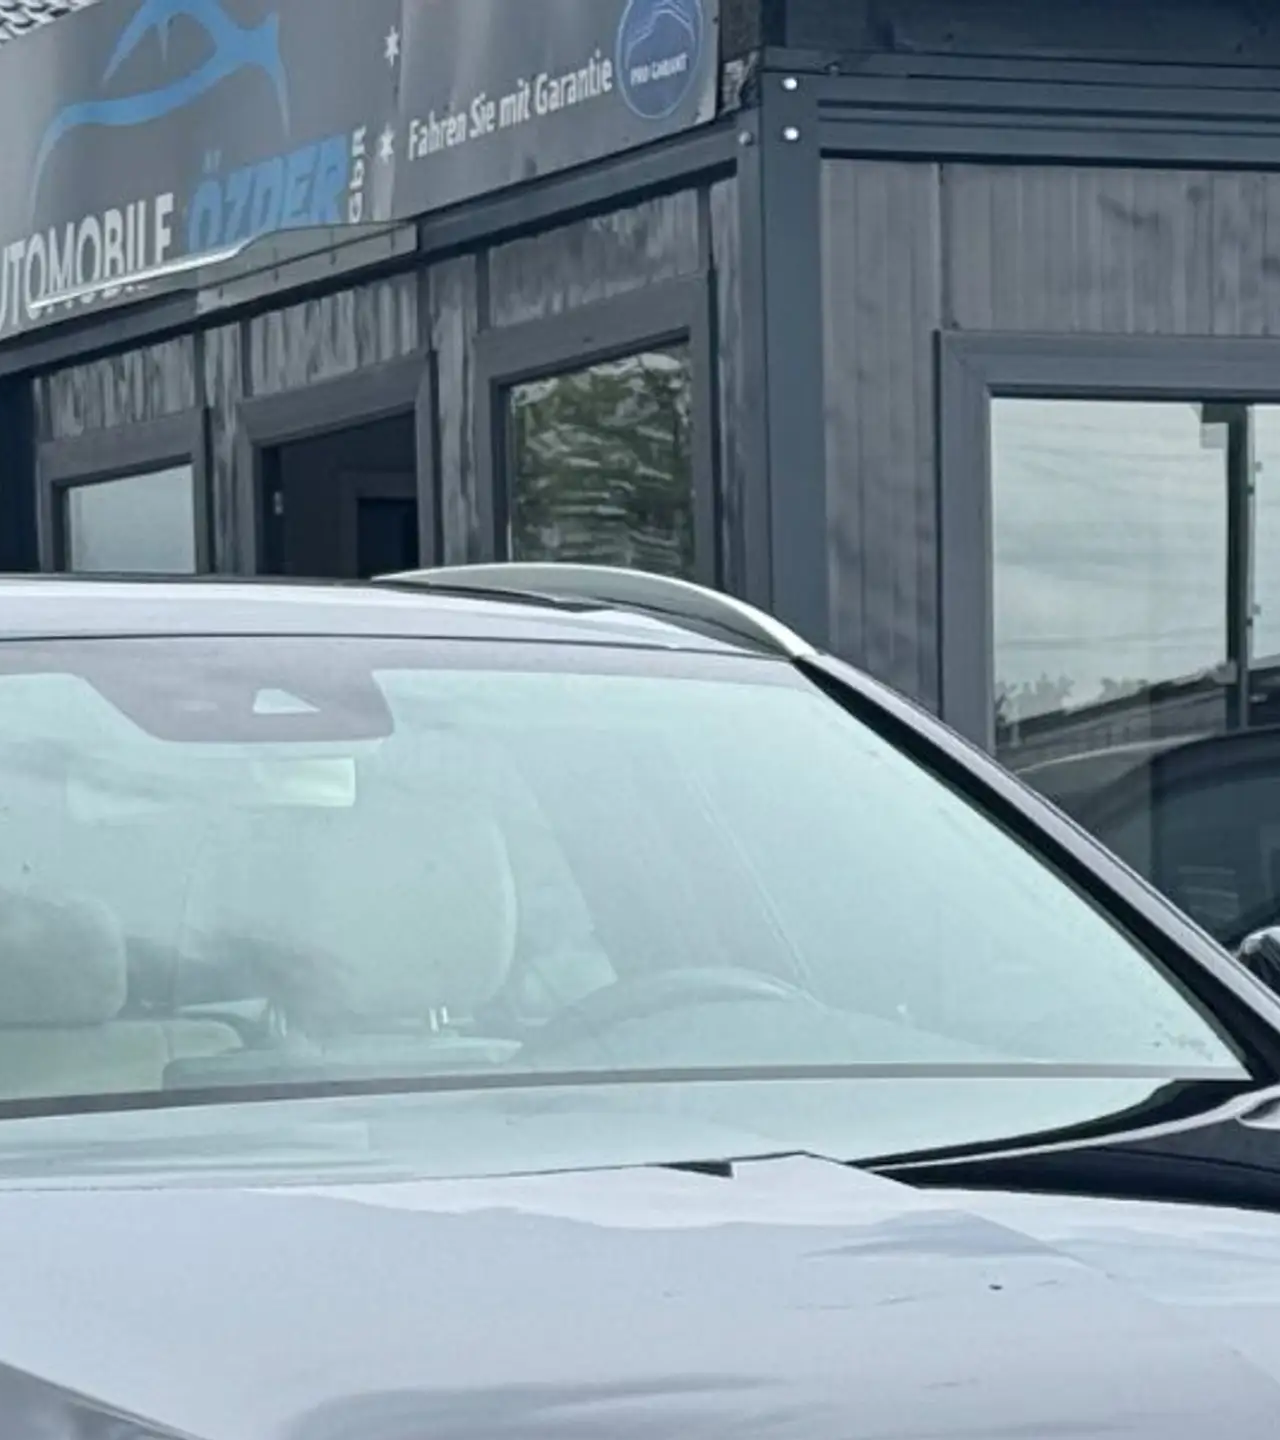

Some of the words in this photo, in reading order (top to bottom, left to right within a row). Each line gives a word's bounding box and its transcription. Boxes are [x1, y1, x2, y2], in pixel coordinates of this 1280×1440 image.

[408, 110, 466, 160] Fahren
[469, 87, 495, 138] Sie
[498, 76, 532, 129] mit
[535, 48, 614, 116] Garantie
